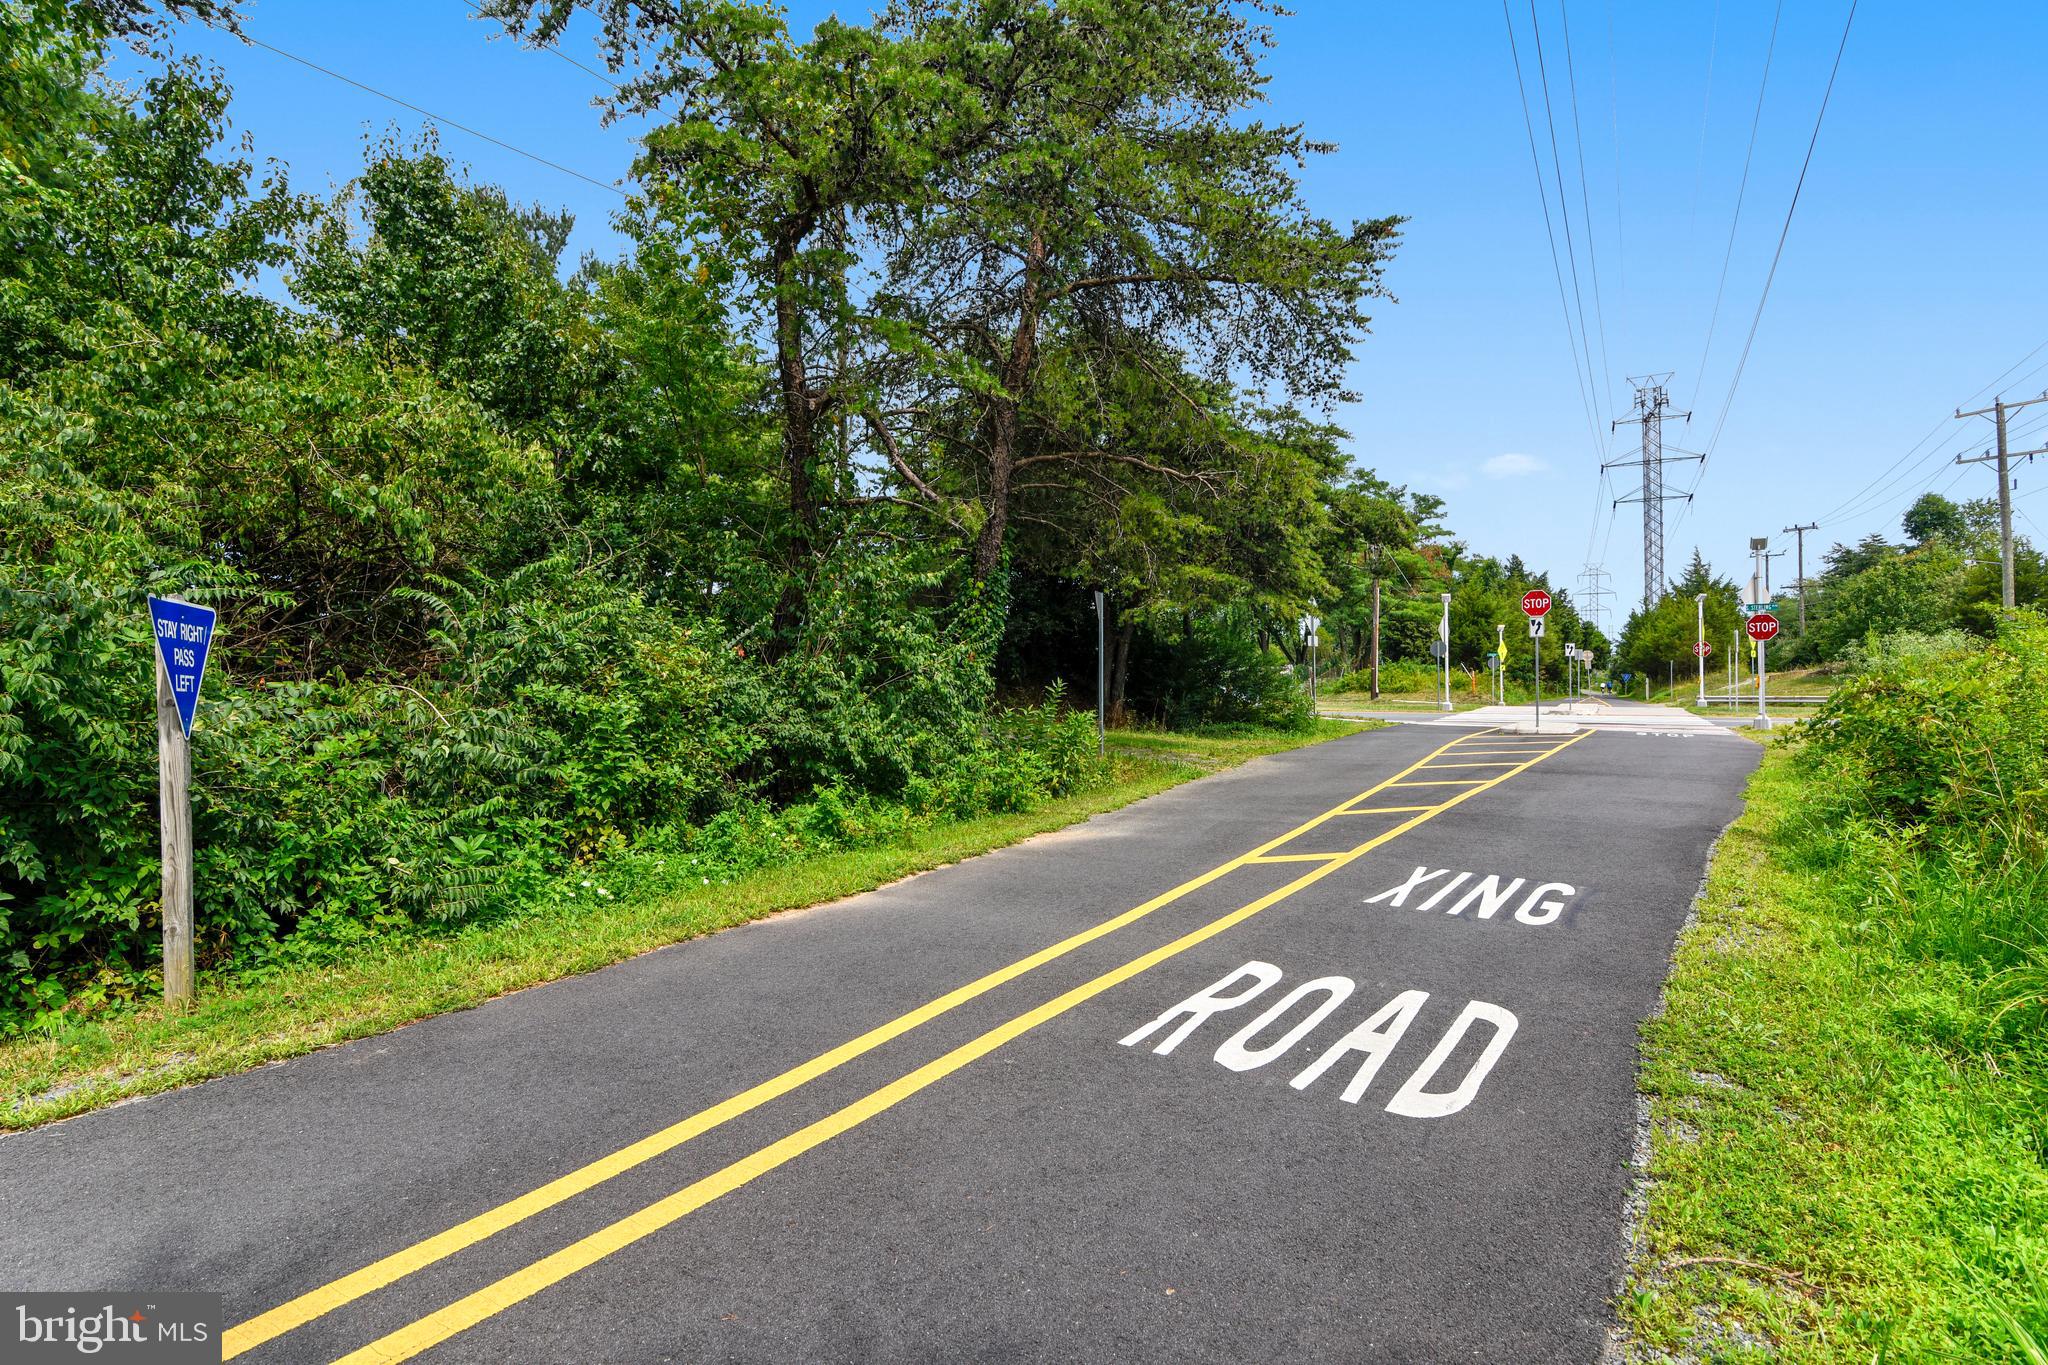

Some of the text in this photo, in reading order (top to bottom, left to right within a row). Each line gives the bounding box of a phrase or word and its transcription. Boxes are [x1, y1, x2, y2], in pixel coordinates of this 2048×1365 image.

[1524, 598, 1549, 609] STOP
[157, 618, 178, 639] STAY
[1748, 621, 1777, 633] STOP
[174, 648, 195, 668] PASS
[175, 674, 195, 693] LEFT
[1362, 866, 1576, 926] XING
[1117, 960, 1519, 1118] ROAD
